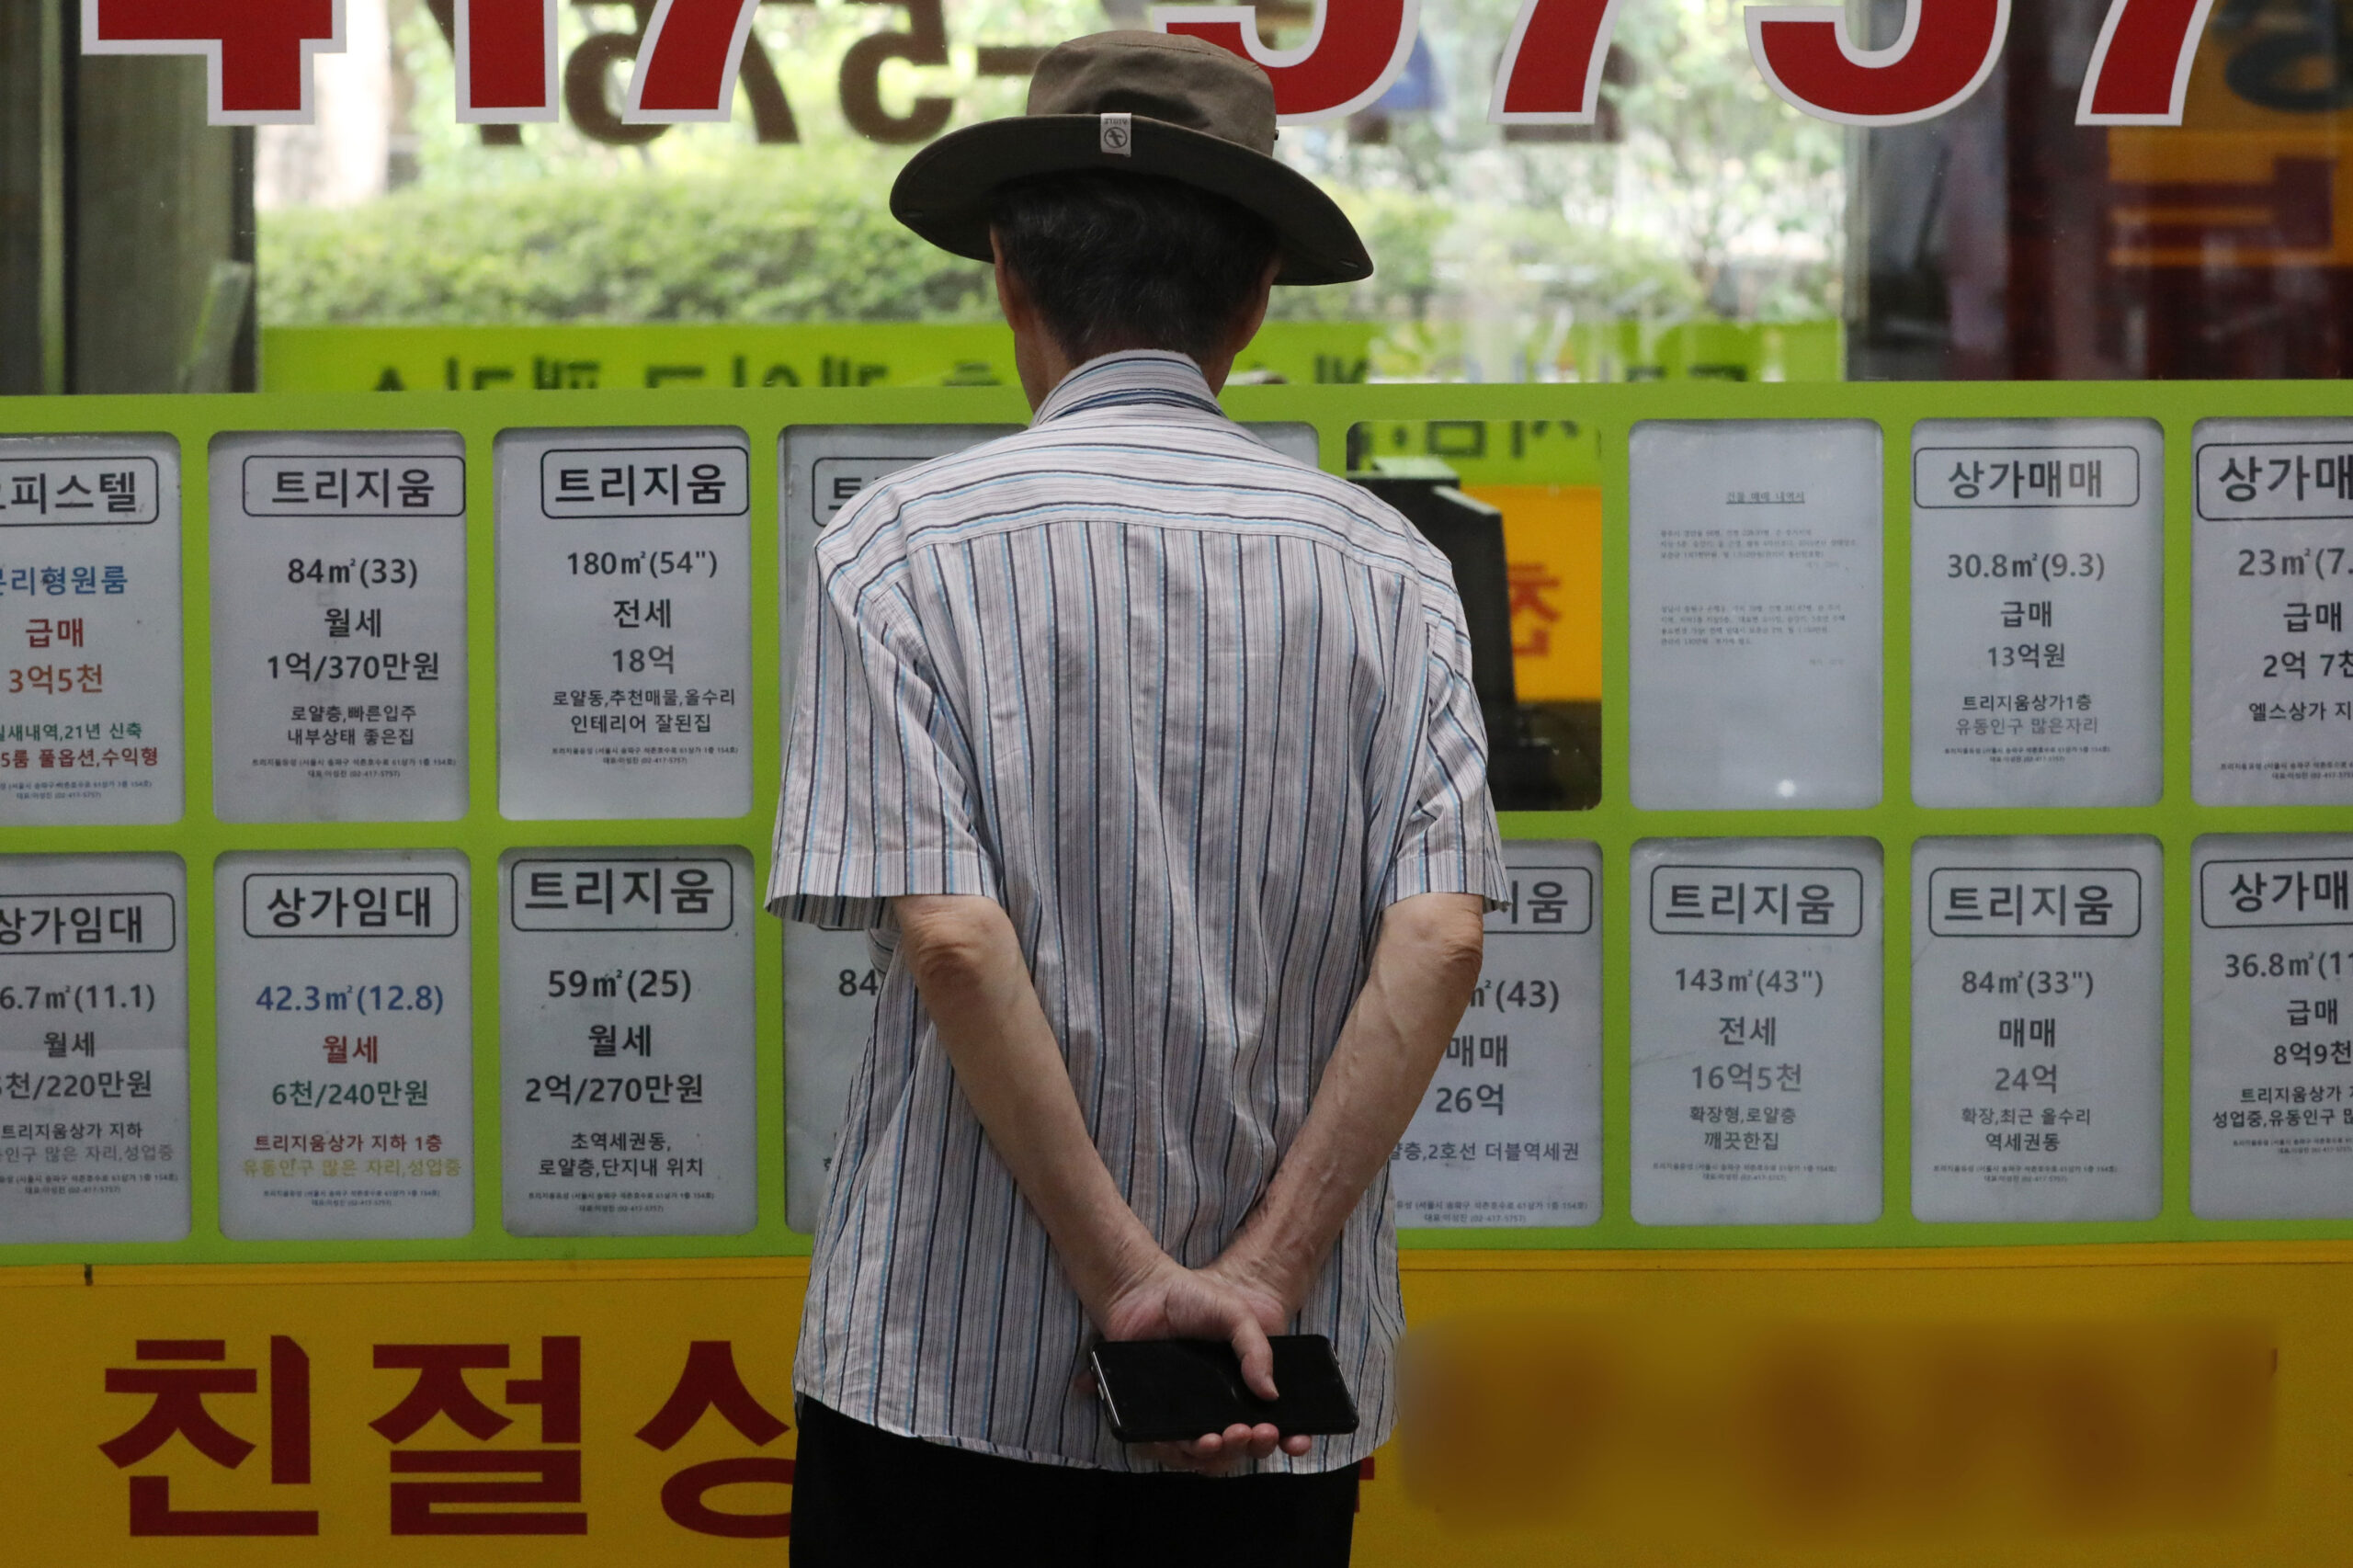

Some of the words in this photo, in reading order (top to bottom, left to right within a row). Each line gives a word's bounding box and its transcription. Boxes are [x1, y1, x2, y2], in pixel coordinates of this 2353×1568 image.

[272, 469, 434, 508] 트리지움
[555, 464, 726, 506] 트리지움
[1949, 460, 2100, 499] 상가매매
[288, 559, 417, 588] 84㎡(33)
[568, 551, 717, 578] 180㎡(54")
[1949, 552, 2104, 582] 30.8㎡(9.3)
[324, 608, 381, 638] 월세
[614, 599, 671, 628] 전세
[2001, 601, 2052, 628] 급매
[2283, 602, 2342, 632] 급매
[26, 618, 84, 648] 급매
[268, 653, 438, 682] 1억/370만원
[612, 645, 673, 674] 18억
[1988, 643, 2064, 668] 13억원
[2264, 651, 2305, 679] 2억
[9, 664, 102, 695] 3억5천
[553, 688, 734, 708] 로얄동,추천매물,올수리
[1962, 694, 2091, 711] 트리지움상가1층
[2249, 701, 2326, 722] 엘스상가
[291, 705, 415, 723] 로얄층,빠른입주
[571, 714, 645, 733] 인테리어
[656, 714, 710, 733] 잘된집
[1956, 718, 2023, 735] 유동인구
[109, 722, 142, 739] 신축
[288, 728, 355, 745] 내부상태
[364, 729, 414, 745] 좋은집
[39, 747, 157, 768] 풀옵션,수익형
[525, 868, 713, 915] 트리지움
[1665, 882, 1835, 925] 트리지움
[1945, 884, 2113, 926] 트리지움
[267, 887, 430, 927] 상가임대
[549, 970, 690, 1003] 59㎡(25)
[1676, 968, 1823, 997] 143㎡(43")
[1961, 971, 2093, 998] 84㎡(33")
[256, 985, 443, 1016] 42.3㎡(12.8)
[2287, 998, 2337, 1026] 급매
[44, 1031, 95, 1058] 월세
[588, 1025, 651, 1057] 월세
[1719, 1016, 1776, 1046] 전세
[1999, 1018, 2055, 1048] 매매
[323, 1036, 378, 1064] 월세
[2273, 1041, 2351, 1066] 8억9천
[526, 1074, 702, 1106] 2억/270만원
[1692, 1062, 1801, 1092] 16억5천
[1995, 1063, 2057, 1094] 24억
[272, 1080, 427, 1108] 6천/240만원
[1436, 1084, 1504, 1116] 26억
[2241, 1085, 2342, 1104] 트리지움상가
[1689, 1106, 1795, 1124] 확장형,로얄층
[1962, 1108, 2033, 1125] 확장,최근
[2041, 1108, 2090, 1125] 올수리
[2213, 1108, 2335, 1129] 성업중,유동인구
[2, 1123, 102, 1140] 트리지움상가
[110, 1122, 142, 1139] 지하
[255, 1134, 363, 1153] 트리지움상가
[371, 1134, 406, 1152] 지하
[415, 1134, 442, 1153] 1층
[571, 1132, 670, 1152] 초역세권동,
[1704, 1131, 1779, 1151] 깨끗한집
[1986, 1133, 2060, 1152] 역세권동
[1485, 1142, 1578, 1161] 더블역세권
[539, 1158, 657, 1177] 로얄층,단지내
[667, 1158, 702, 1176] 위치
